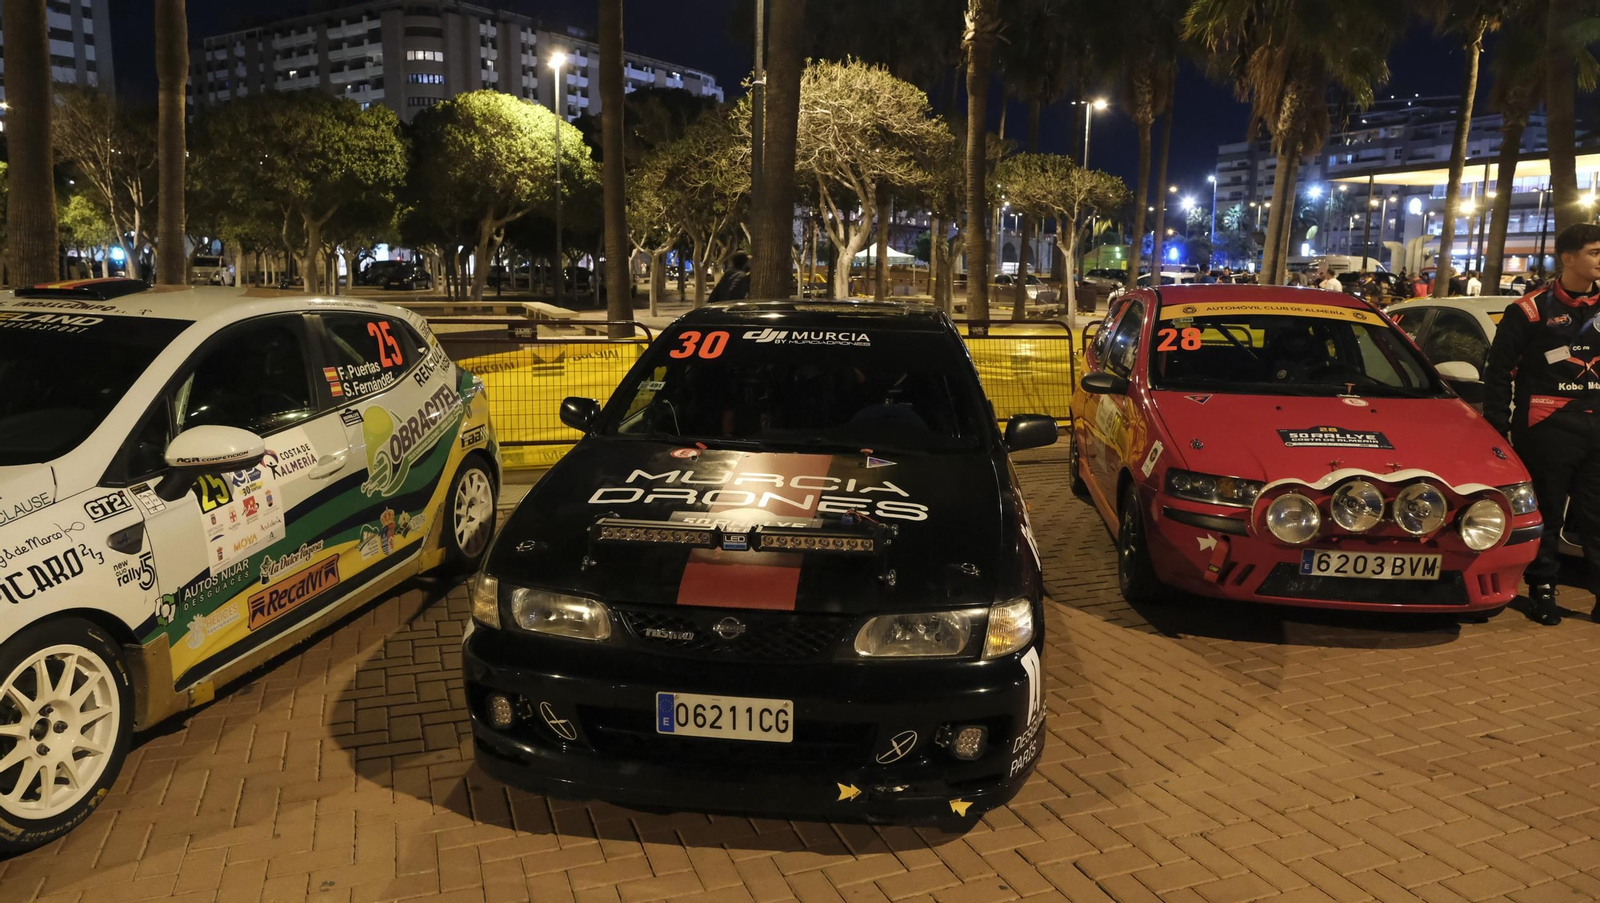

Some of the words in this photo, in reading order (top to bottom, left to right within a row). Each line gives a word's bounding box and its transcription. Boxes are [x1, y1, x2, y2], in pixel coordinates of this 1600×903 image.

[1206, 304, 1262, 312] AUTOMÓVIL
[1304, 307, 1346, 316] ALMERÍA
[367, 321, 403, 368] 25
[669, 330, 730, 359] 30
[791, 331, 870, 342] MURCIA
[1157, 327, 1202, 352] 28
[338, 366, 348, 381] F.
[349, 361, 381, 380] Puertas
[413, 343, 442, 388] RENAULT
[1558, 382, 1584, 391] Kobe
[390, 383, 460, 463] OBRACITEL
[279, 446, 301, 460] COSTA
[301, 443, 311, 453] DE
[281, 453, 318, 477] ALMERÍA
[197, 474, 230, 512] 25
[242, 485, 251, 497] 30
[625, 469, 910, 497] MURCIA
[588, 487, 929, 521] DRONES
[25, 532, 63, 549] Marco
[724, 535, 746, 544] LED
[0, 548, 84, 604] ICARO
[113, 559, 128, 572] new
[1317, 552, 1385, 576] 6203
[1391, 556, 1438, 577] BVM
[184, 574, 219, 601] AUTOS
[221, 558, 249, 581] NIJAR
[184, 570, 249, 611] DESGUACES
[663, 716, 670, 727] E
[675, 702, 790, 733] 06211CG
[1010, 740, 1037, 777] PARÍS
